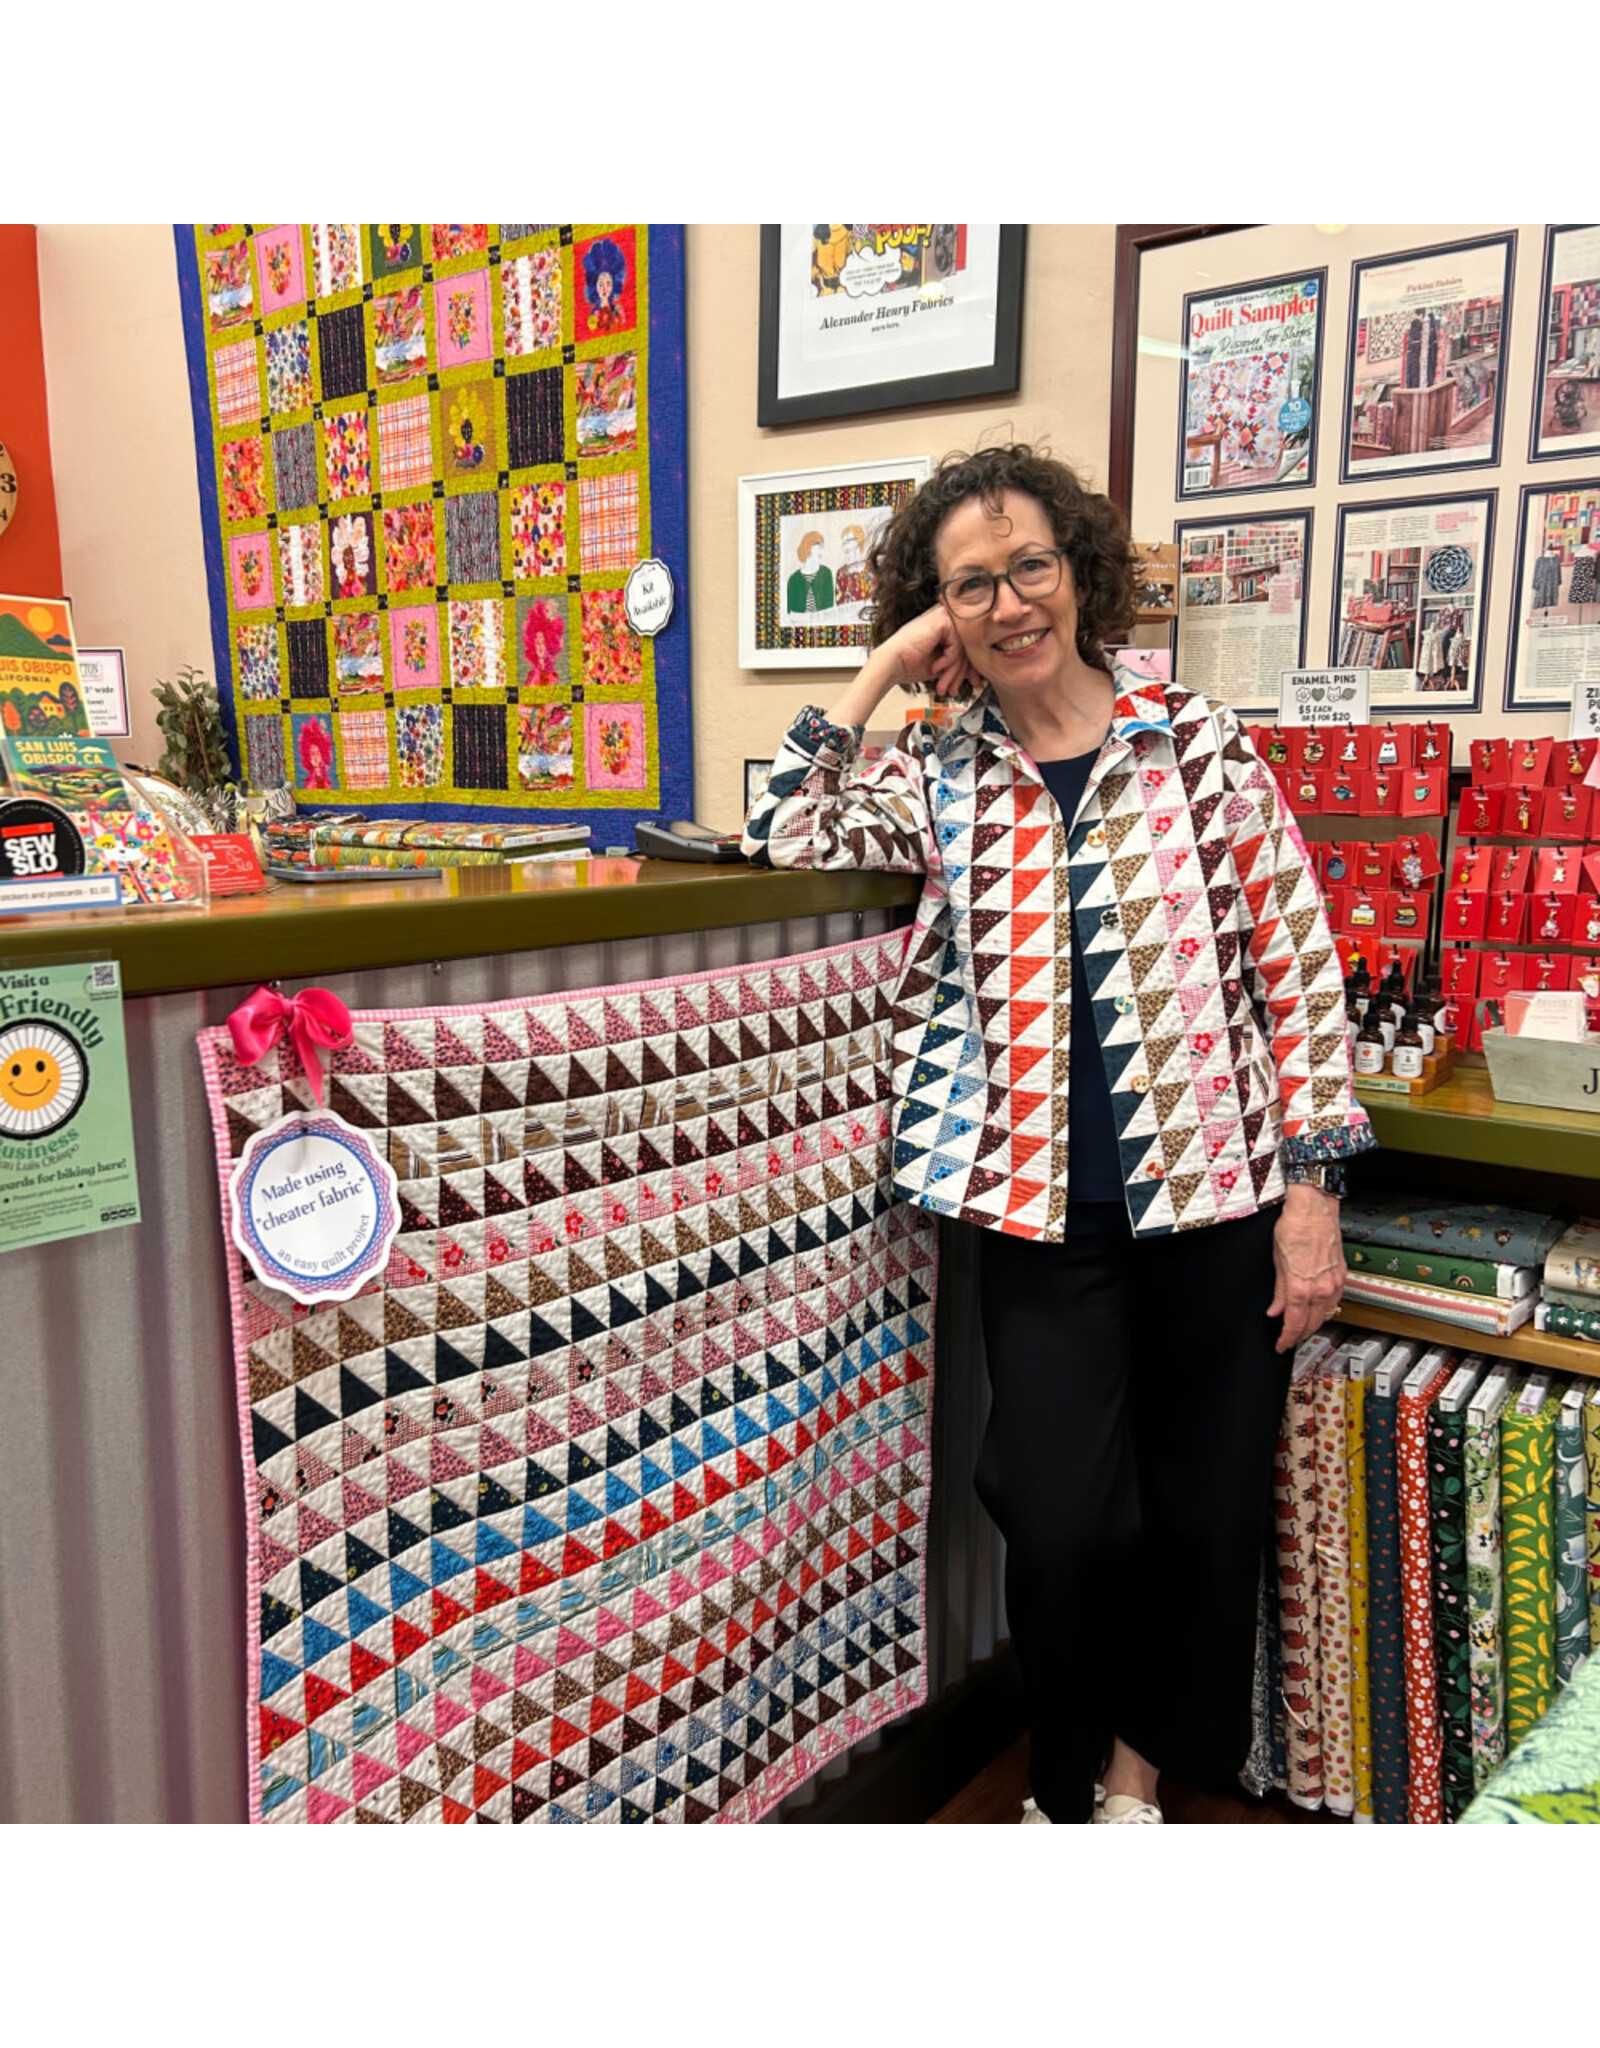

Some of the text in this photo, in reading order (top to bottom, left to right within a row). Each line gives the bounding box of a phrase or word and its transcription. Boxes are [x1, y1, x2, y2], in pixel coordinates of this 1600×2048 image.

[819, 295, 955, 331] Alexander Henry Fabrics
[1191, 294, 1318, 338] Quilt Sampler
[1288, 401, 1301, 411] 10
[22, 661, 72, 675] OBISPO
[1292, 674, 1357, 686] ENAMEL PINS
[1299, 704, 1333, 715] $5 EACH
[1332, 712, 1351, 722] $20
[15, 740, 78, 753] SAN LUIS
[82, 754, 103, 766] CA
[4, 834, 56, 859] SEW
[12, 853, 58, 876] SLO
[31, 890, 45, 898] and
[0, 973, 50, 990] Visit a
[0, 990, 104, 1049] Friendly
[16, 1162, 40, 1172] Luis
[41, 1143, 80, 1168] Obispo
[37, 1174, 55, 1185] for
[56, 1166, 95, 1181] biking
[97, 1158, 127, 1173] here!
[261, 1160, 348, 1202] Made using
[256, 1176, 366, 1232] "cheater fabric"
[277, 1213, 370, 1273] an easy quilt project
